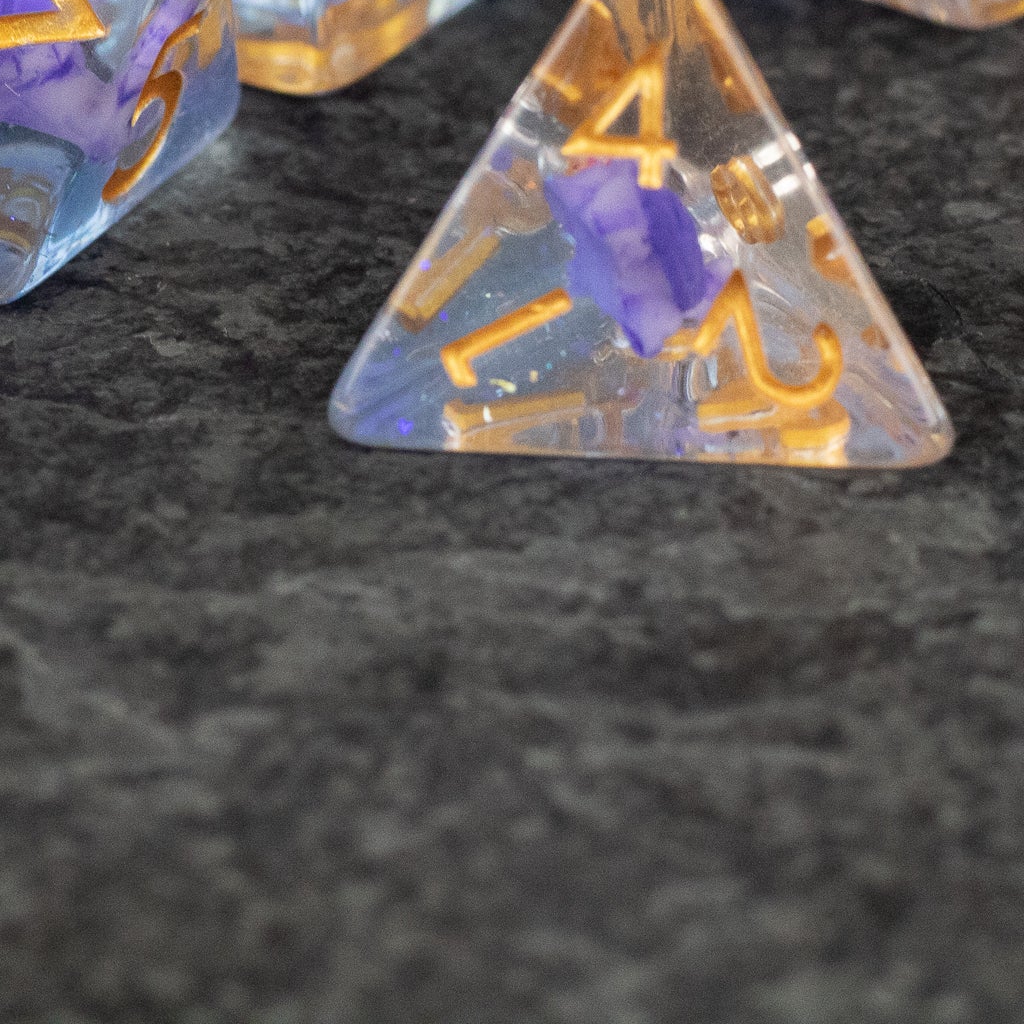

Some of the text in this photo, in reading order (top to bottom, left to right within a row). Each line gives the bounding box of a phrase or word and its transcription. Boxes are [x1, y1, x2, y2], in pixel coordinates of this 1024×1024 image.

[561, 56, 676, 190] 4
[441, 287, 573, 388] 1
[693, 269, 844, 408] 2
